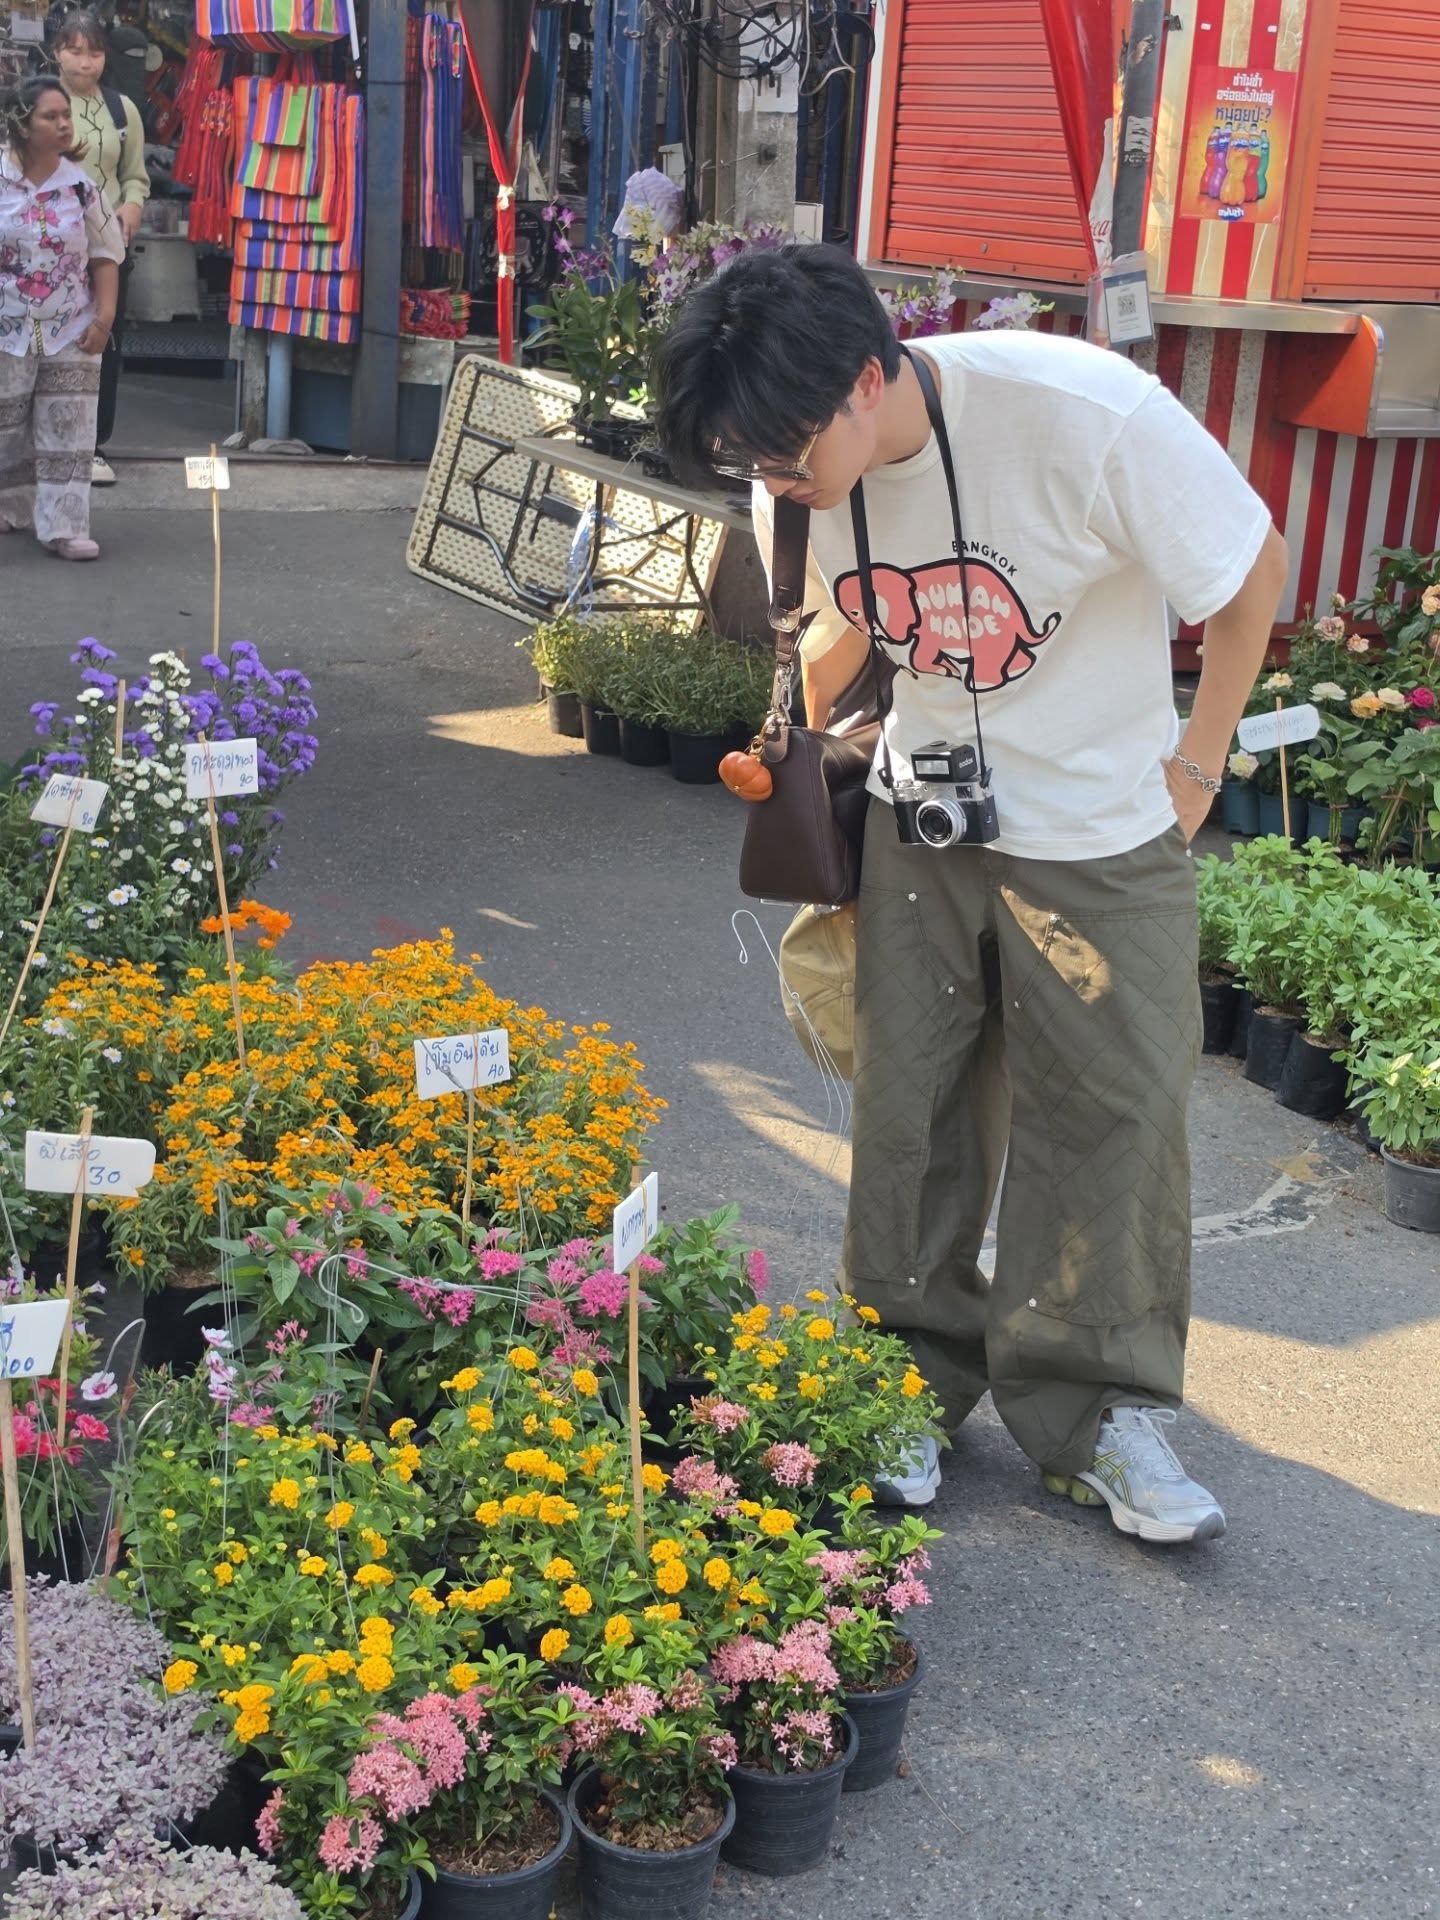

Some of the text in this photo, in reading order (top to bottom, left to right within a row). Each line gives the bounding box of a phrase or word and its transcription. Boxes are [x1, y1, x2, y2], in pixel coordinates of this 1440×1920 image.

[952, 540, 1018, 577] BANGKOK
[915, 582, 1012, 619] HUMAN
[929, 614, 1001, 640] MADE
[488, 1063, 504, 1080] 40
[89, 1166, 121, 1185] 30
